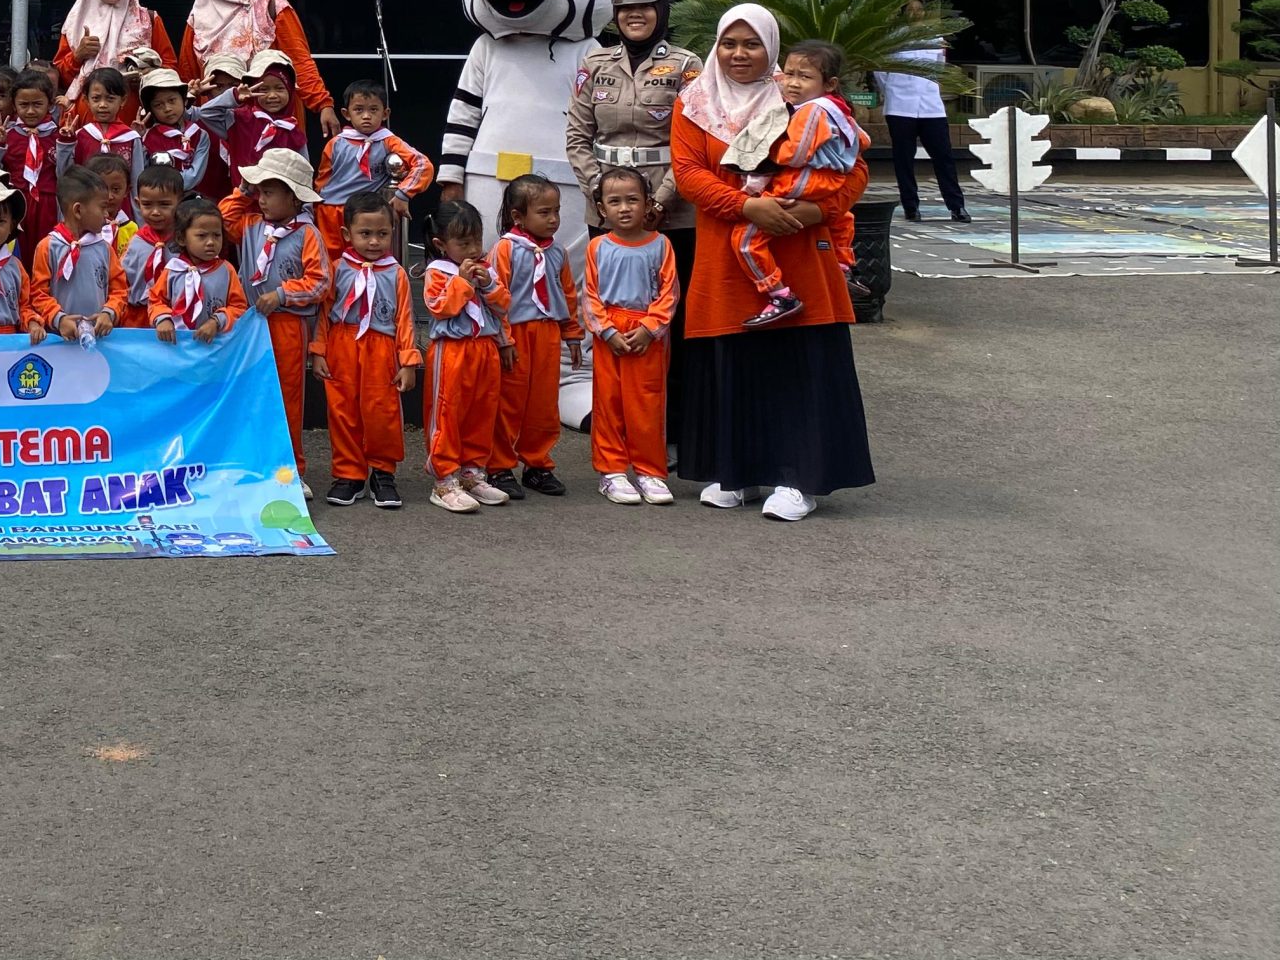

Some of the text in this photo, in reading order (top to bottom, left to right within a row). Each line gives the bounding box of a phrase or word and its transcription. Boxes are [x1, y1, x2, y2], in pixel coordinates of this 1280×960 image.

[595, 76, 616, 86] AYU
[643, 78, 676, 87] POLRI
[9, 524, 200, 534] BANDUNGSARI
